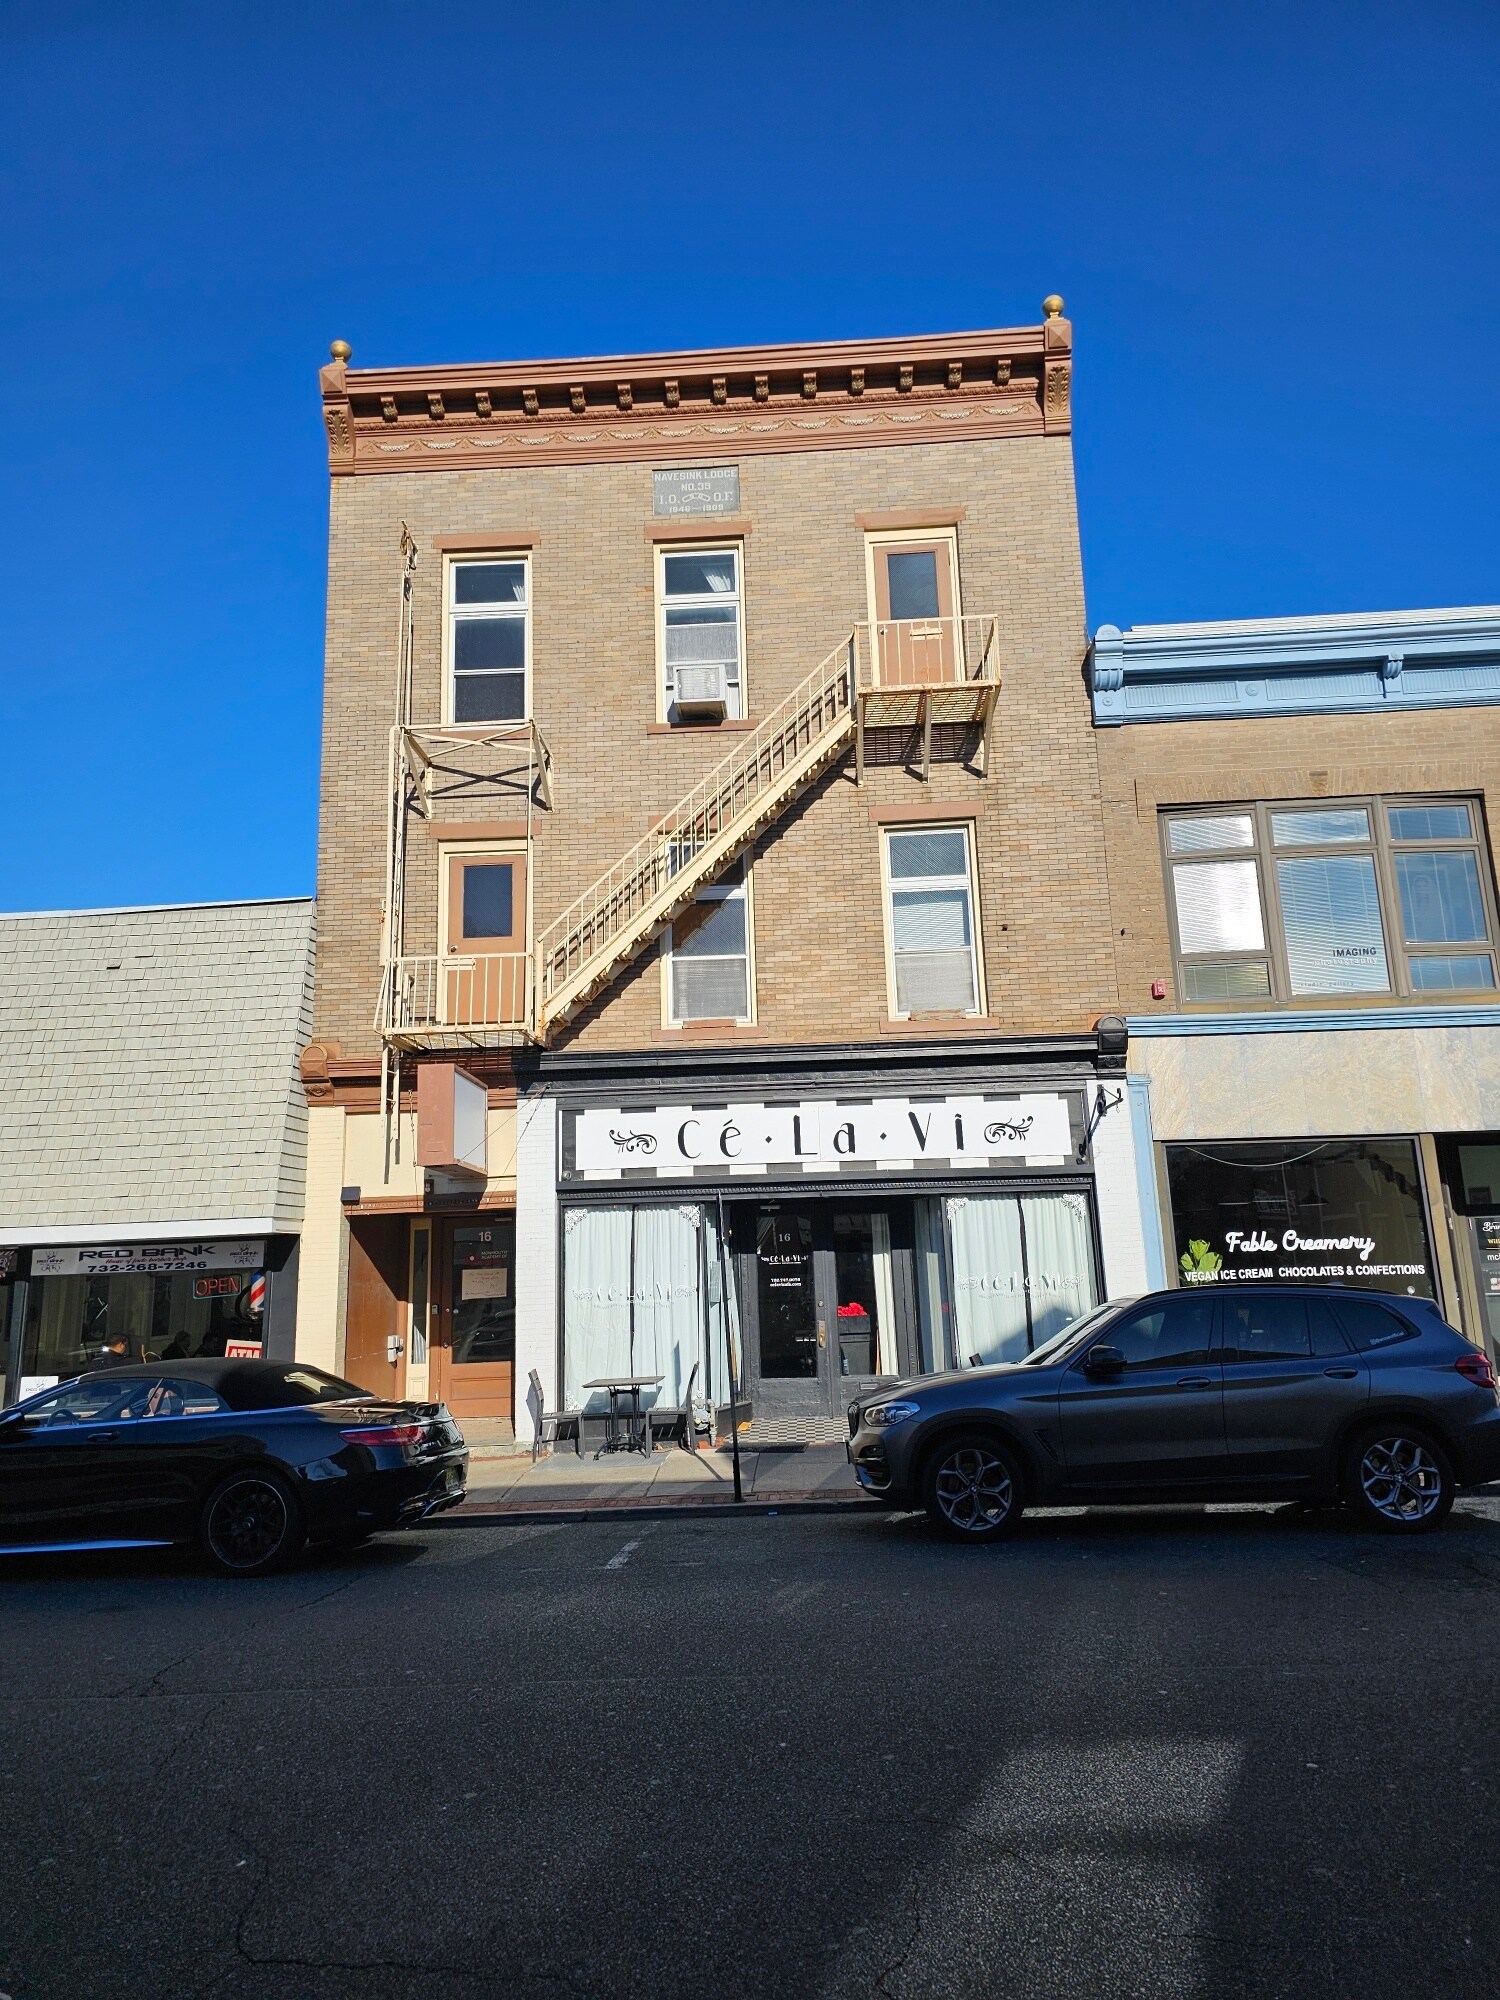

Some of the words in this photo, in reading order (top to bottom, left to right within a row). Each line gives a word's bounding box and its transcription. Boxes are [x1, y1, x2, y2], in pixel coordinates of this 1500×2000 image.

[654, 471, 702, 482] NAVESINK
[704, 469, 737, 479] LODGE
[1333, 947, 1377, 957] IMAGING
[677, 1119, 742, 1159] Cé
[793, 1114, 855, 1156] La
[908, 1111, 964, 1152] Vi
[478, 1231, 492, 1242] 16
[779, 1233, 791, 1242] 16
[1225, 1231, 1278, 1252] Fable
[1282, 1229, 1376, 1261] Creamery
[79, 1249, 134, 1262] RED
[88, 1261, 207, 1273] 732-268-7246
[1184, 1271, 1219, 1281] VEGAN
[1220, 1269, 1237, 1280] ICE
[1238, 1267, 1274, 1279] CREAM
[1279, 1265, 1344, 1277] CHOCOLATES
[1346, 1266, 1354, 1276] &
[1355, 1264, 1426, 1276] CONFECTIONS
[196, 1277, 239, 1296] OPEN
